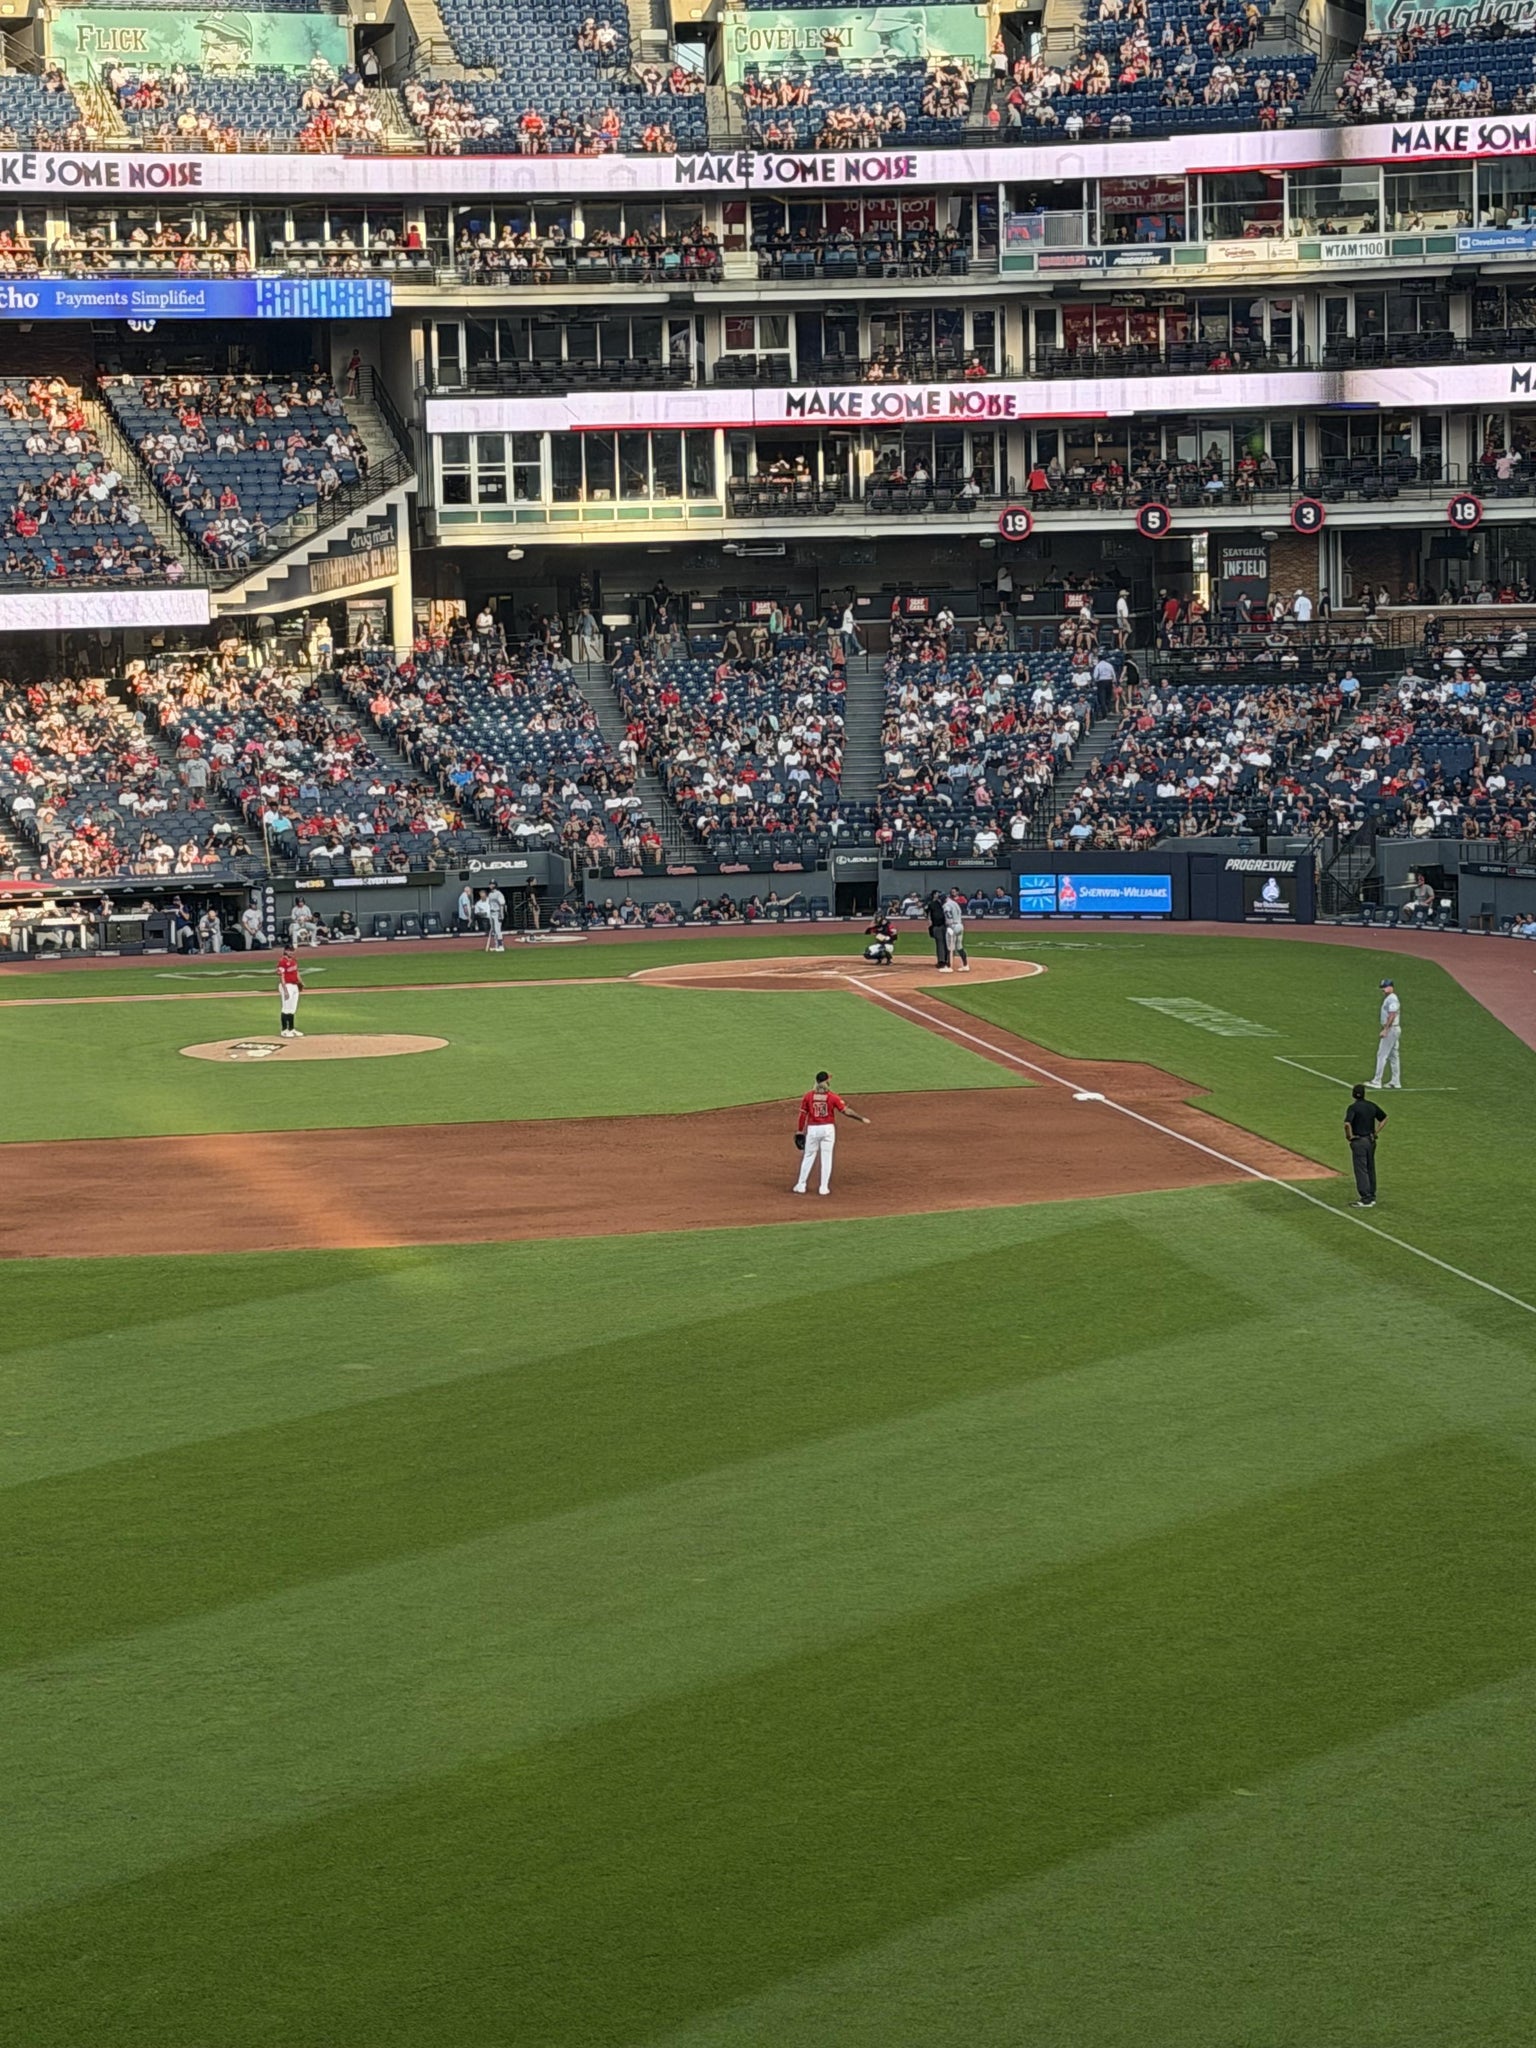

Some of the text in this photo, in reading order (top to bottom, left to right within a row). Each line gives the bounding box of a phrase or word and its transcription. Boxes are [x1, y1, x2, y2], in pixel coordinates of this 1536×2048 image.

[76, 24, 148, 52] FLICK
[1391, 122, 1536, 154] MAKE SOM
[0, 154, 202, 188] KE SOME NOISE
[675, 152, 917, 183] MAKE SOME NOISE
[1087, 255, 1103, 266] TV
[0, 286, 205, 309] cho Payments Simplified
[785, 389, 863, 417] MAKE
[871, 391, 940, 417] SOME
[1147, 512, 1161, 528] 5
[1302, 507, 1315, 524] 3
[1455, 503, 1476, 520] 18
[1006, 515, 1027, 531] 19
[350, 532, 372, 550] drug
[372, 526, 395, 543] mart
[1222, 546, 1267, 558] SEATGEEK
[309, 545, 398, 593] CHAMPIONS CLUB
[1222, 559, 1267, 580] INFIELD
[482, 860, 528, 870] LEXUS
[1225, 858, 1297, 872] PROGRESSIVE
